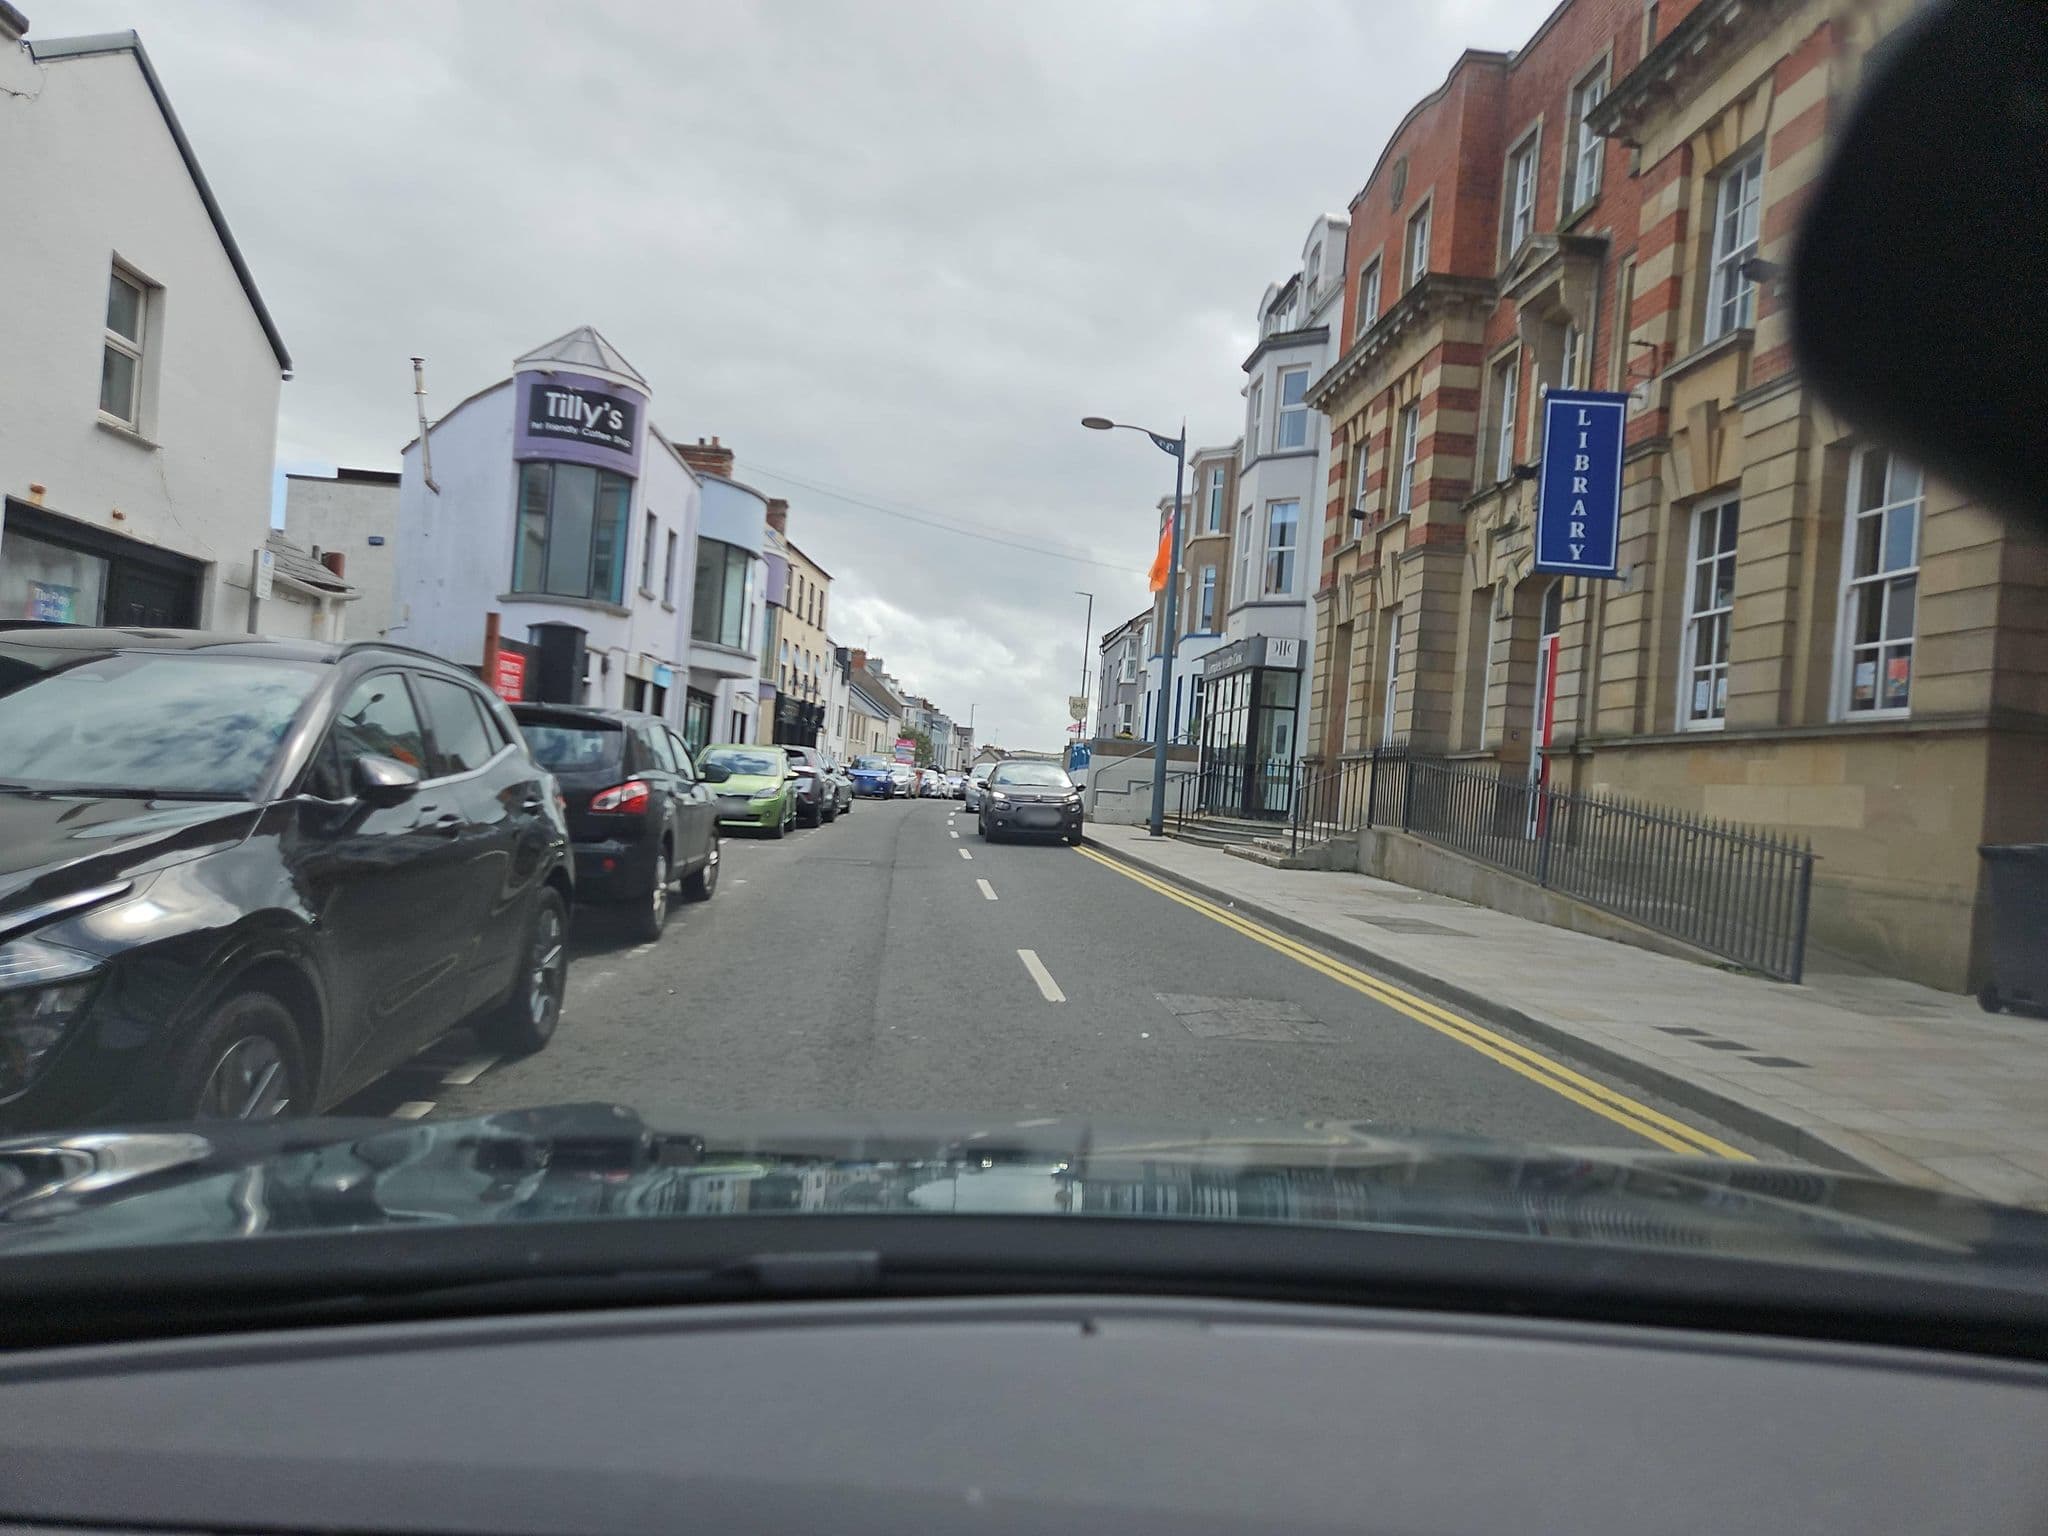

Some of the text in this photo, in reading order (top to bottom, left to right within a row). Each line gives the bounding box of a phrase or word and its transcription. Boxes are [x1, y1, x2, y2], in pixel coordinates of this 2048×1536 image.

[545, 391, 624, 430] Tilly's
[581, 427, 612, 441] Coffee
[1567, 408, 1592, 561] LIBRARY
